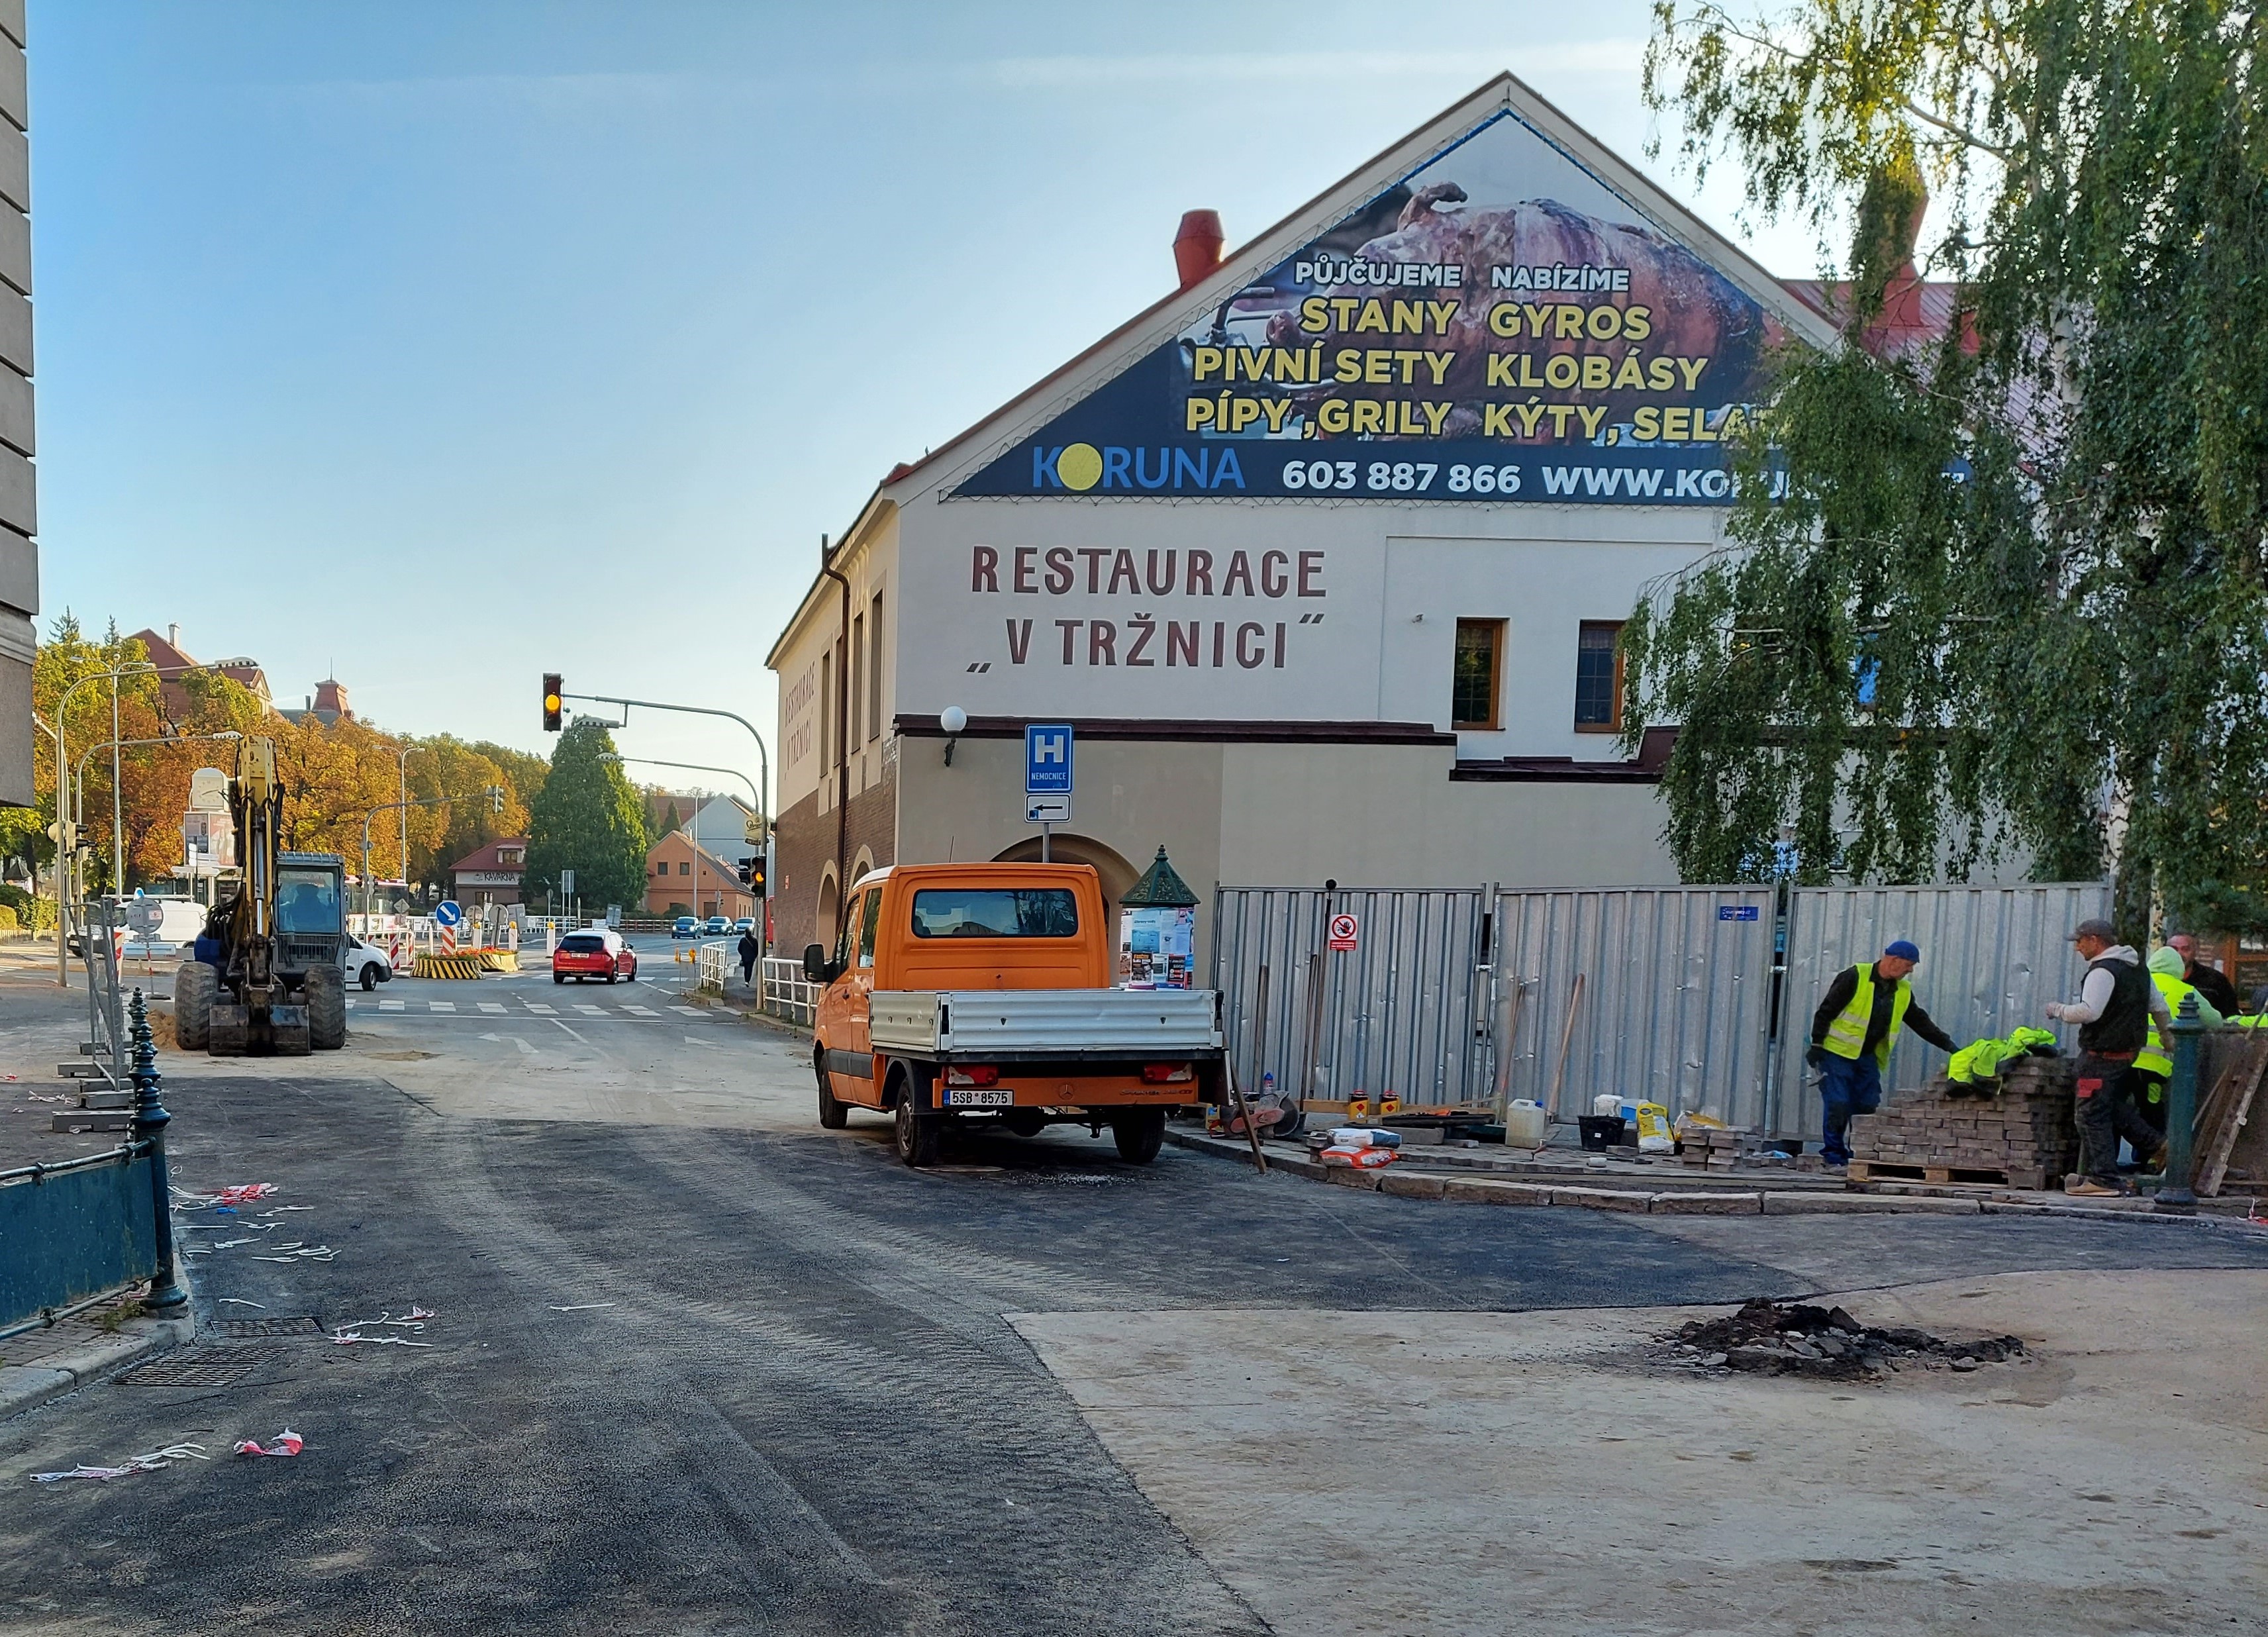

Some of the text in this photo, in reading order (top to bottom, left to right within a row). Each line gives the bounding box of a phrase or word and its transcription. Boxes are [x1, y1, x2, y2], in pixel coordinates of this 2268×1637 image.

[1296, 255, 1461, 287] PŮJČUJEME
[1491, 263, 1630, 291] NABÍZÍME
[1301, 297, 1458, 334] STANY
[1489, 303, 1651, 340] GYROS
[1195, 340, 1455, 385] PIVNÍ SETY
[1487, 348, 1708, 391] KLOBÁSY
[1484, 397, 1621, 446] KÝTY,
[1033, 442, 1246, 491] KORUNA
[1283, 460, 1522, 494] 603 887 866
[971, 545, 1326, 598] RESTAURACE
[785, 660, 815, 728] RESTAURACE
[1035, 735, 1064, 763] H
[953, 1092, 1008, 1104] 5SB 8575
